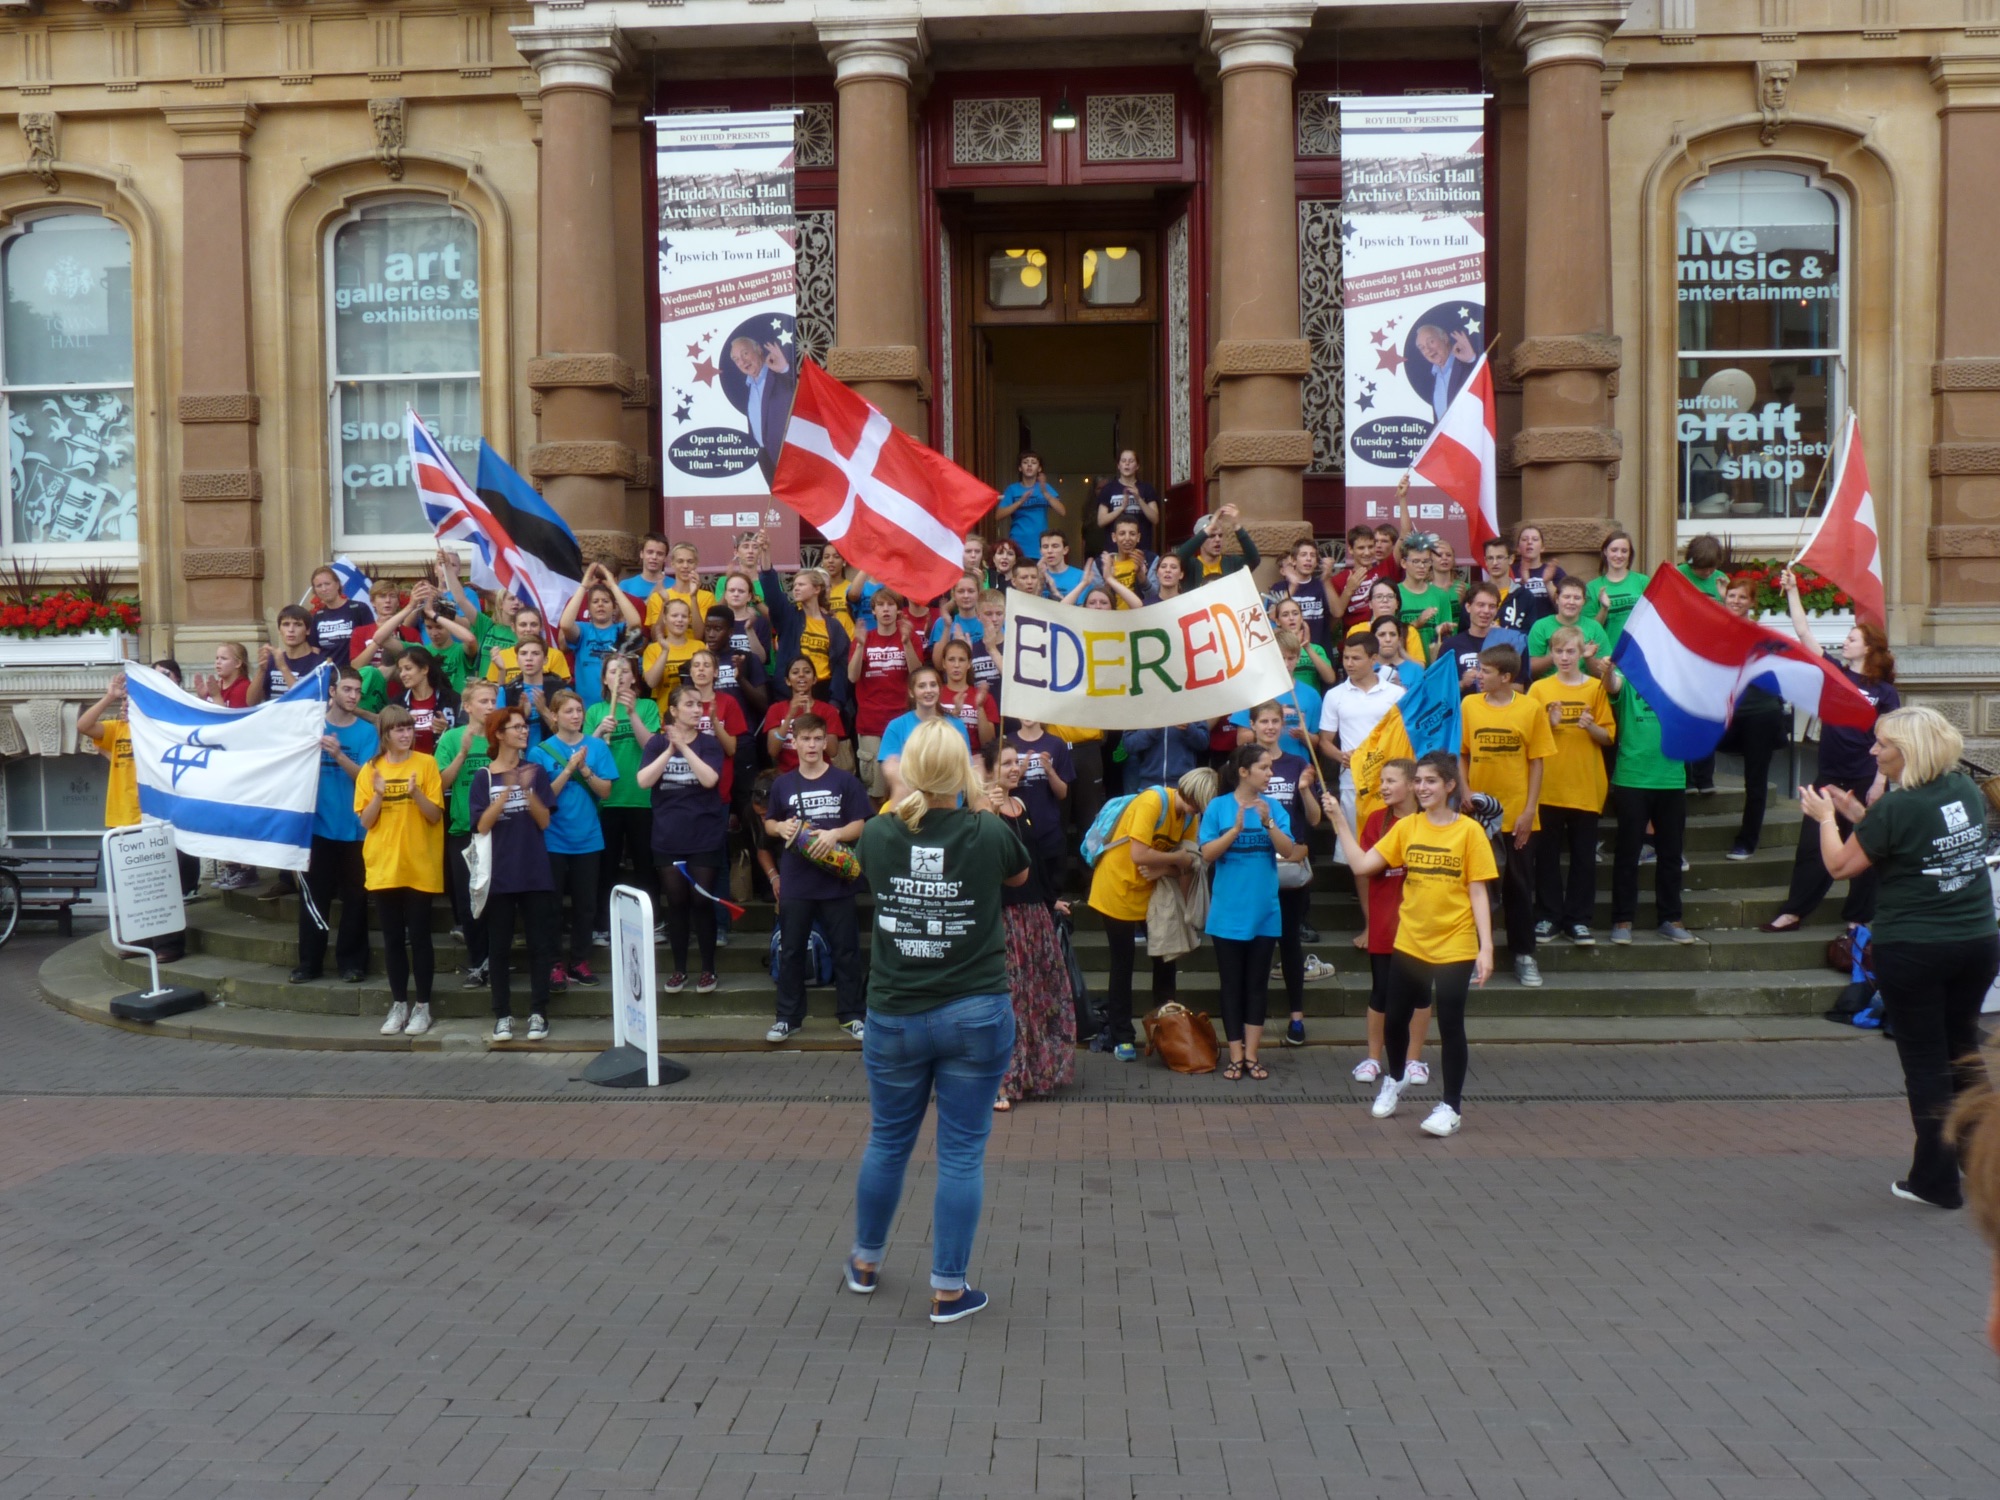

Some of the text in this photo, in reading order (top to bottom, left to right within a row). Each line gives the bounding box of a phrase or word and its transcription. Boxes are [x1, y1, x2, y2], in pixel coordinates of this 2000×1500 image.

[1414, 116, 1459, 124] PRESENTS
[680, 132, 770, 142] ROY HUDD PRESENTS
[1352, 169, 1474, 184] Hudd Music Hall
[668, 184, 786, 200] Hudd Music Hall
[1346, 188, 1481, 202] Archive Exhibition
[662, 202, 792, 219] Archive Exhibition
[1359, 235, 1468, 249] Ipswich Town Hall
[1678, 227, 1758, 255] live
[384, 242, 462, 282] art
[675, 248, 780, 264] Ipswich Town Hall
[1678, 252, 1824, 280] music &
[1345, 258, 1481, 291] Wednesday 14th August 2013
[336, 279, 479, 308] galleries &
[662, 270, 792, 306] Wednesday 14th August 2013
[1358, 288, 1400, 302] Saturday
[1404, 283, 1422, 294] 31st
[1424, 276, 1457, 290] August
[1460, 270, 1482, 282] 2013
[1678, 284, 1840, 301] entertainment
[674, 300, 716, 317] Saturday
[718, 296, 736, 306] 31st
[738, 288, 770, 302] August
[772, 282, 794, 295] 2013
[362, 305, 480, 324] exhibitions
[1677, 395, 1738, 410] suffolk
[342, 415, 440, 440] snos
[1372, 424, 1426, 434] Open daily,
[1677, 402, 1801, 442] craft
[438, 436, 482, 452] ffee
[690, 434, 742, 446] Open daily,
[1354, 438, 1393, 448] Tuesday
[1402, 436, 1426, 446] Satur
[672, 448, 709, 458] Tuesday
[717, 446, 760, 457] Saturday
[1372, 450, 1397, 459] 10am
[1407, 450, 1418, 460] 4p
[343, 455, 413, 487] caf
[688, 460, 713, 470] 10am
[722, 460, 744, 470] 4pm
[1722, 454, 1805, 485] shop
[1014, 602, 1246, 697] EDERED
[118, 836, 168, 852] Town Hall
[124, 852, 166, 865] Galleries
